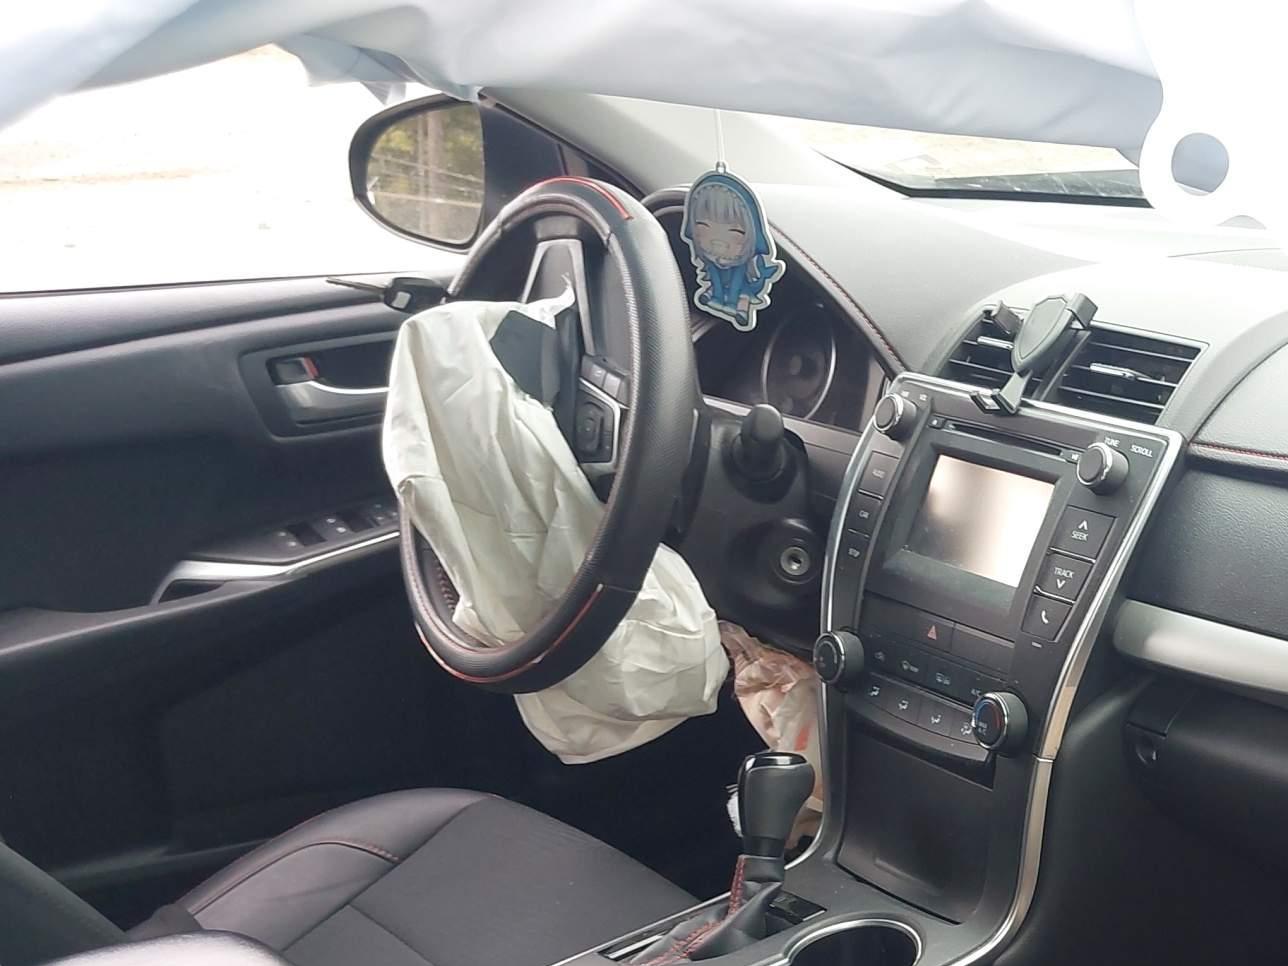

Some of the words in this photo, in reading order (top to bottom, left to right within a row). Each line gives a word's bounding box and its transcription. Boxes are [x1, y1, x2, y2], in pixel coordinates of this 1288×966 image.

[1130, 444, 1153, 458] SCROLL
[1071, 530, 1089, 541] SEEK
[1054, 566, 1076, 579] TRACK
